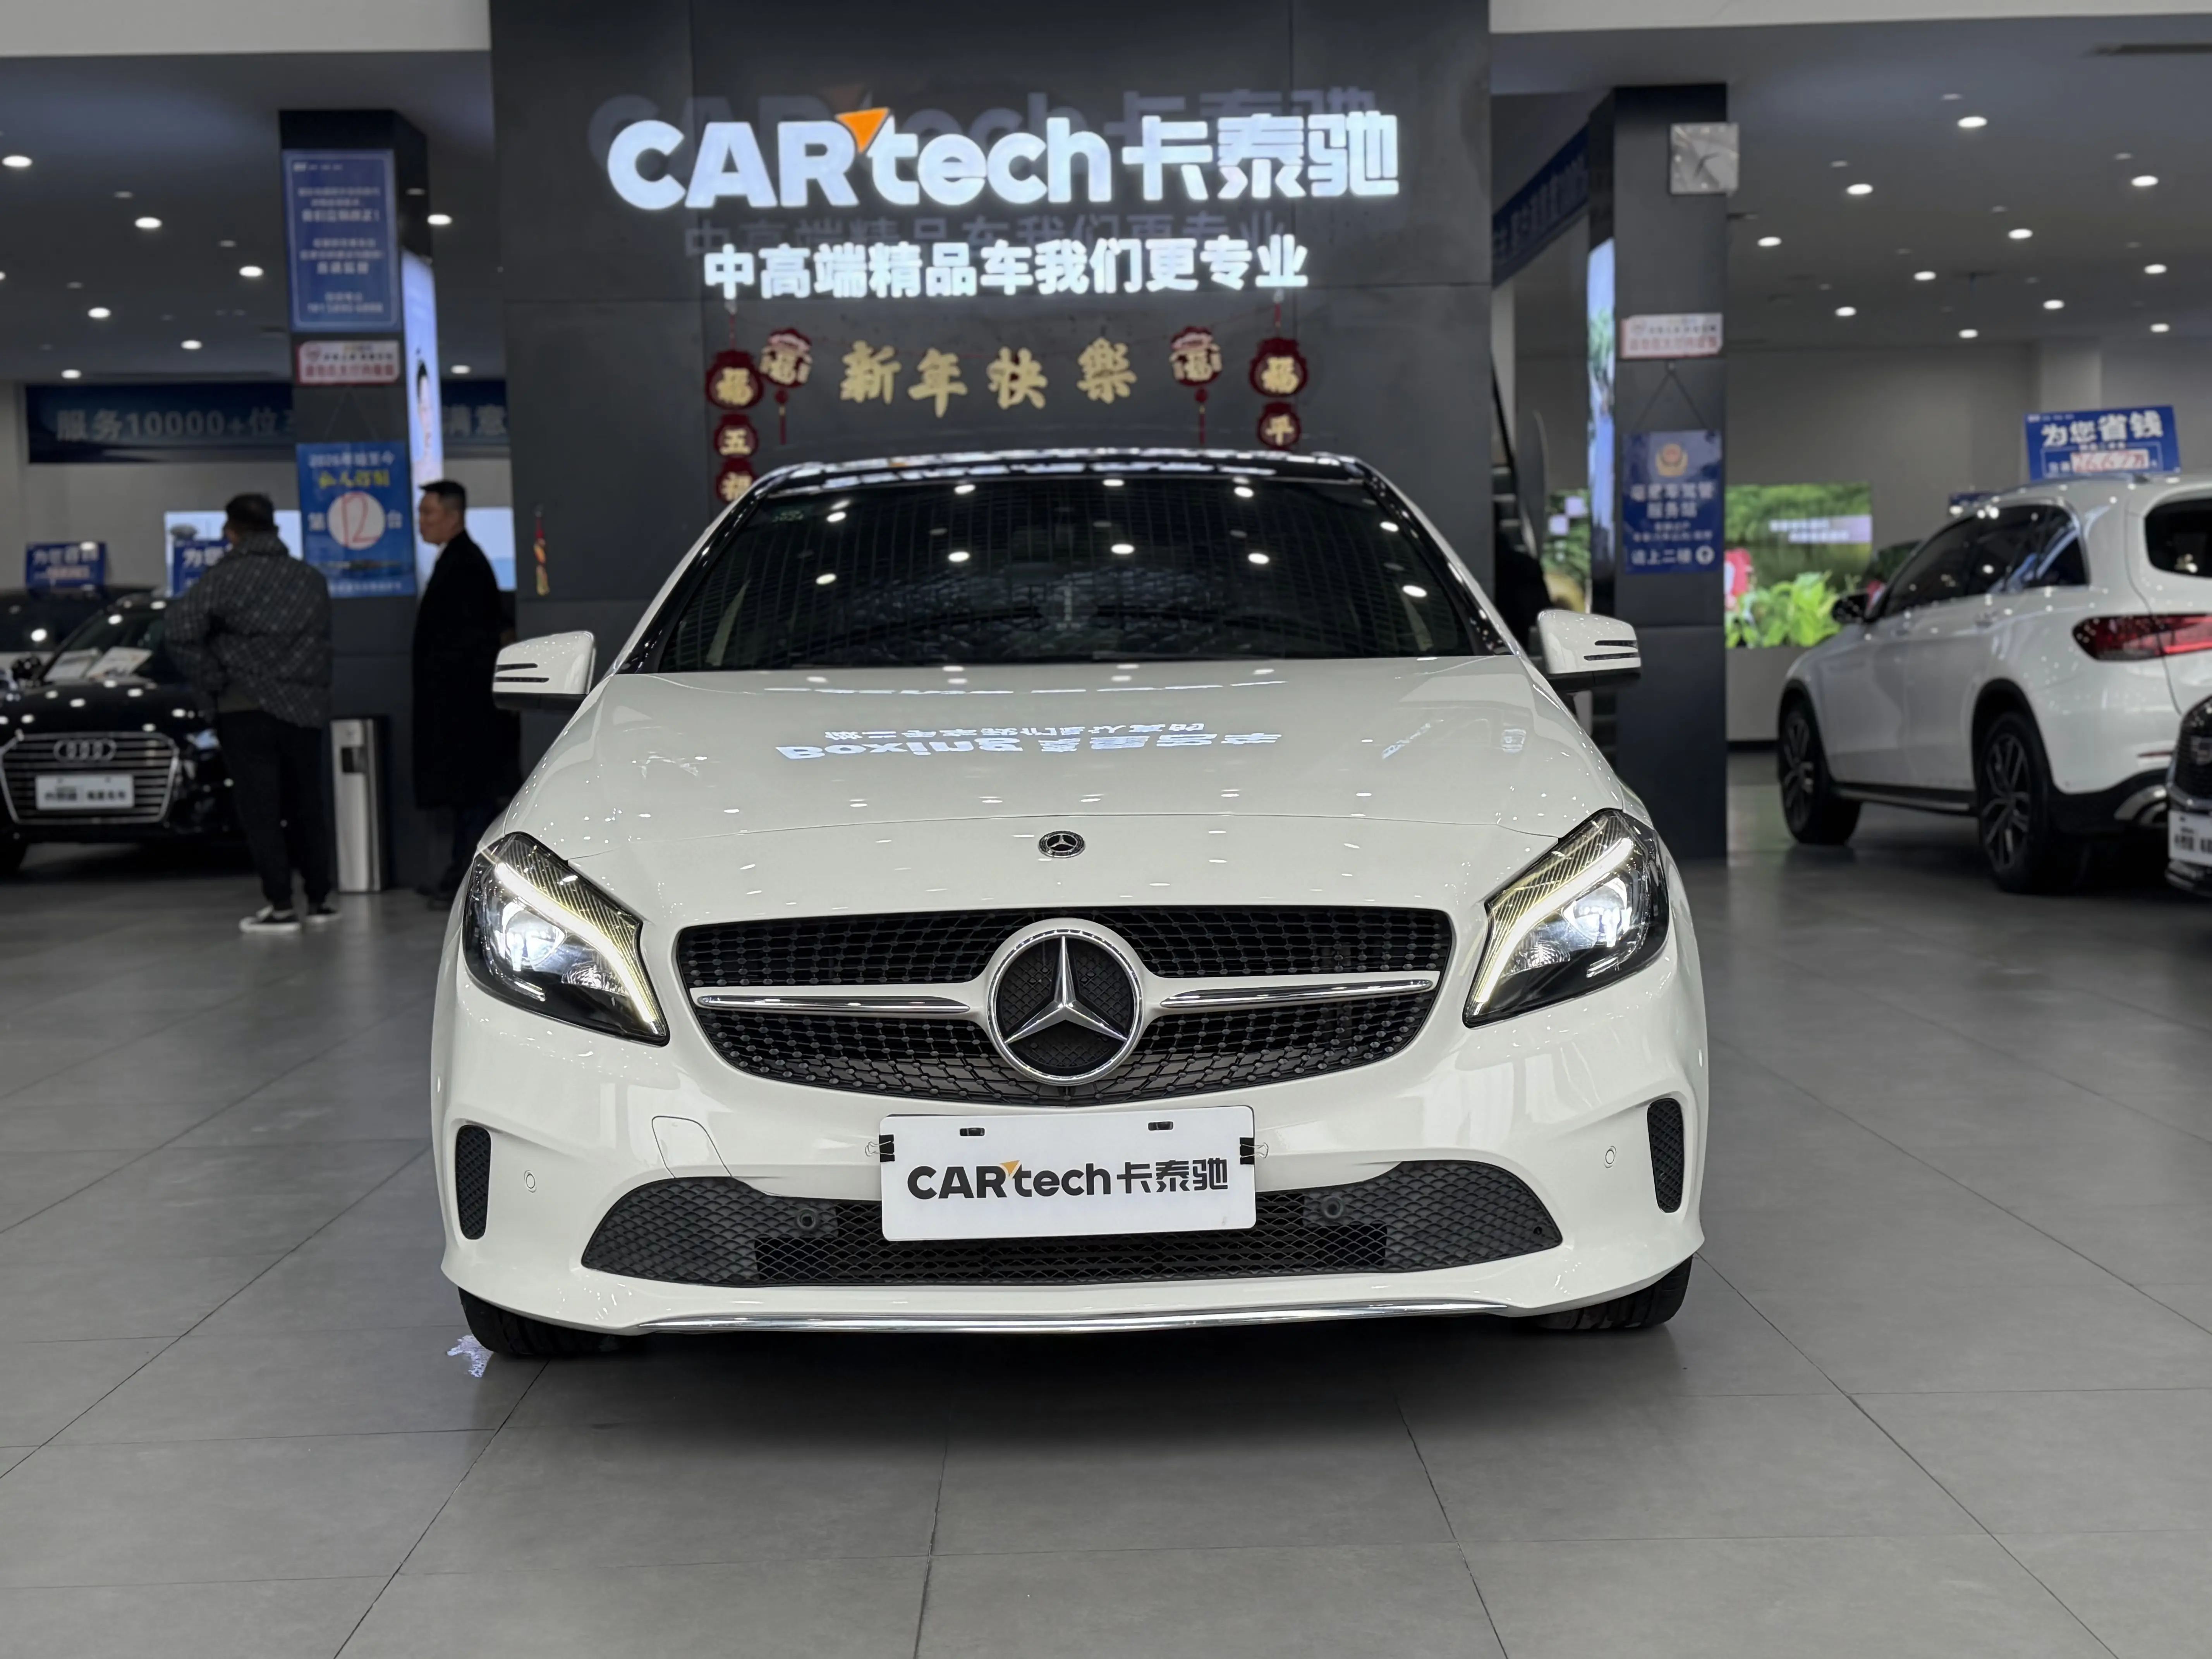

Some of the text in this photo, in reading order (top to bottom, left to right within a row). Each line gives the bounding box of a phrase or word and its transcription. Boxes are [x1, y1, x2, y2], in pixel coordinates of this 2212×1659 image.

[607, 110, 1399, 210] CARtech 卡泰驰
[704, 234, 1309, 299] 中高端精品车我们更专业
[2041, 410, 2163, 448] 为您省钱
[907, 1157, 1228, 1200] CARtech 卡泰驰
